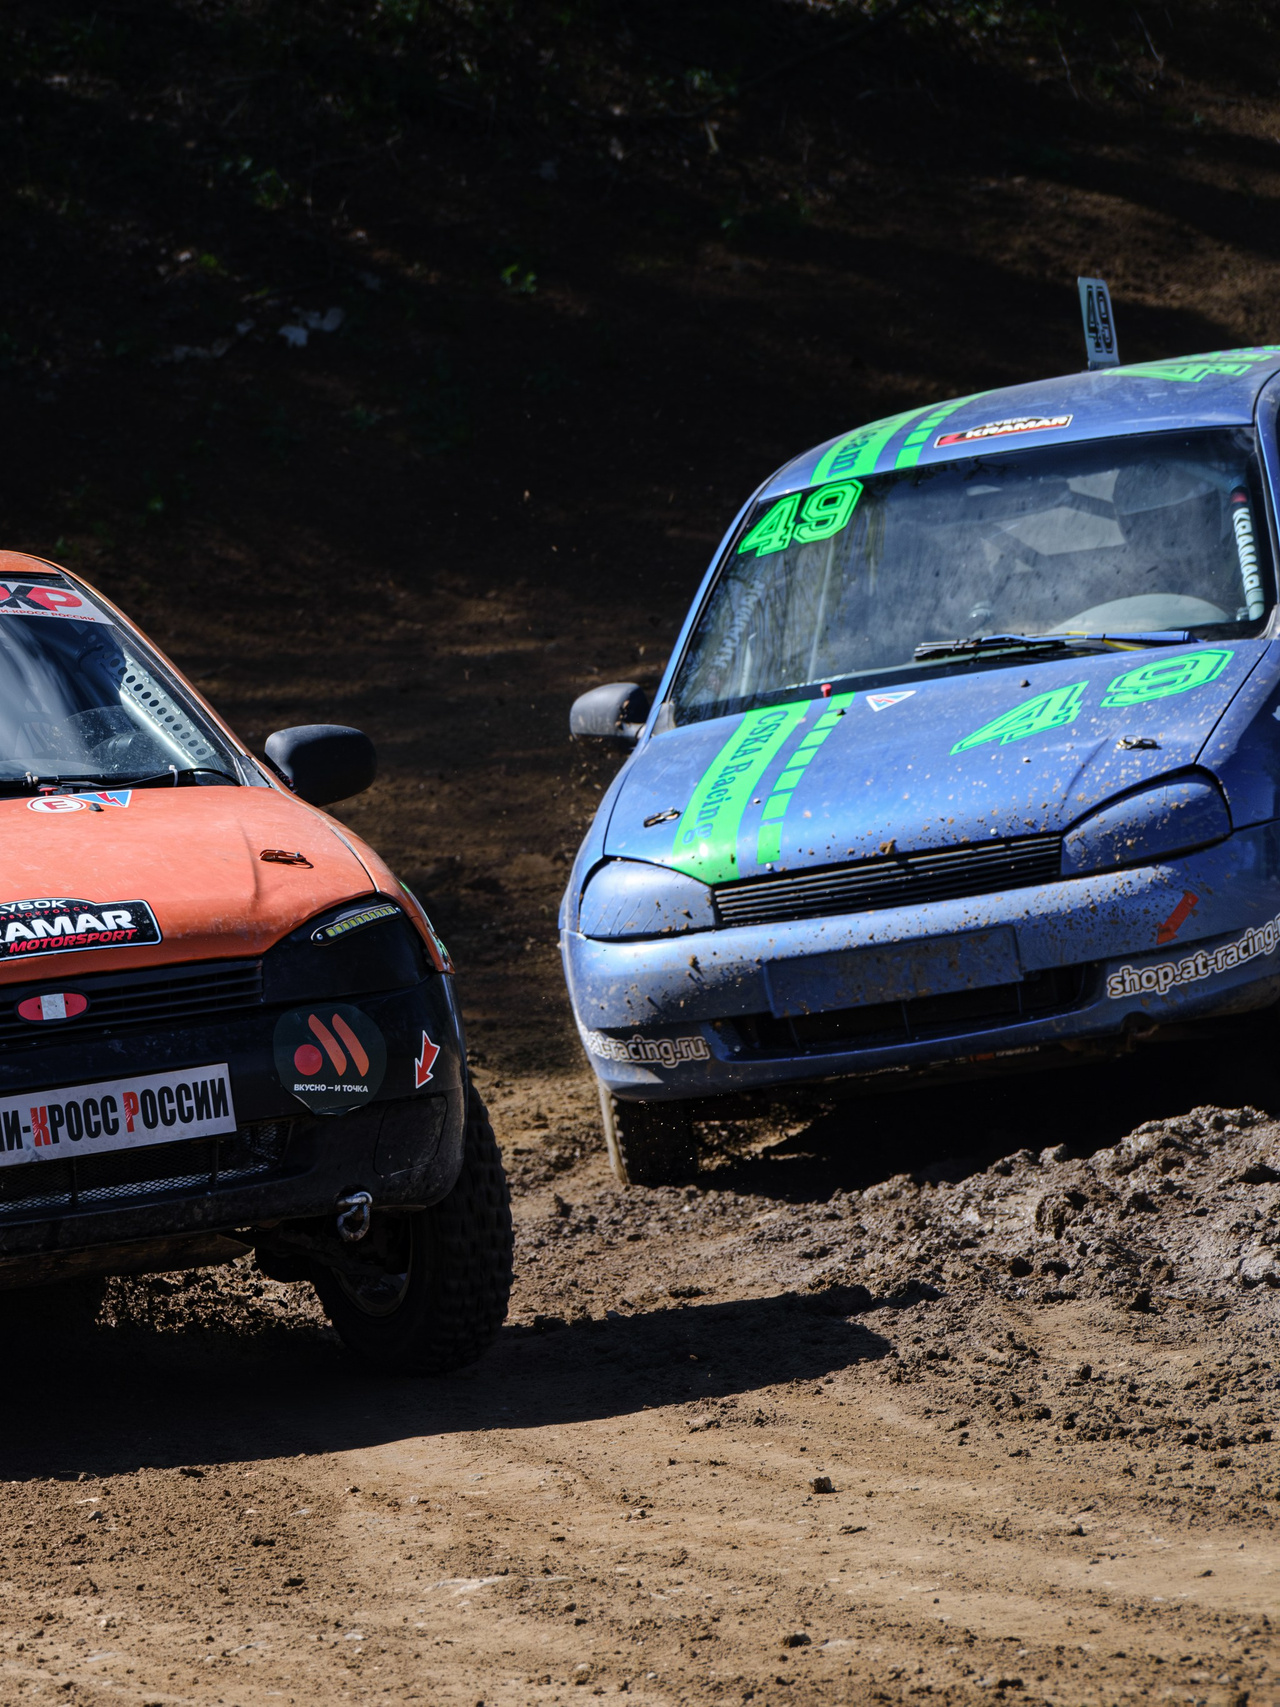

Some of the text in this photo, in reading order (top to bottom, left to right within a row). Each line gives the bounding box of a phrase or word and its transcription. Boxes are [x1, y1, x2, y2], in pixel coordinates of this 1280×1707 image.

[1086, 285, 1114, 354] 49
[966, 416, 1068, 438] KRAMAR
[737, 479, 864, 558] 49
[1232, 507, 1261, 595] KRAMAR
[949, 648, 1235, 757] 49
[682, 710, 789, 845] CSKA Racing
[9, 928, 138, 953] MOTORSPORT
[123, 1077, 229, 1133] РОССИИ
[293, 1083, 326, 1092] ВКУСНО
[342, 1084, 369, 1093] ТОЧКА
